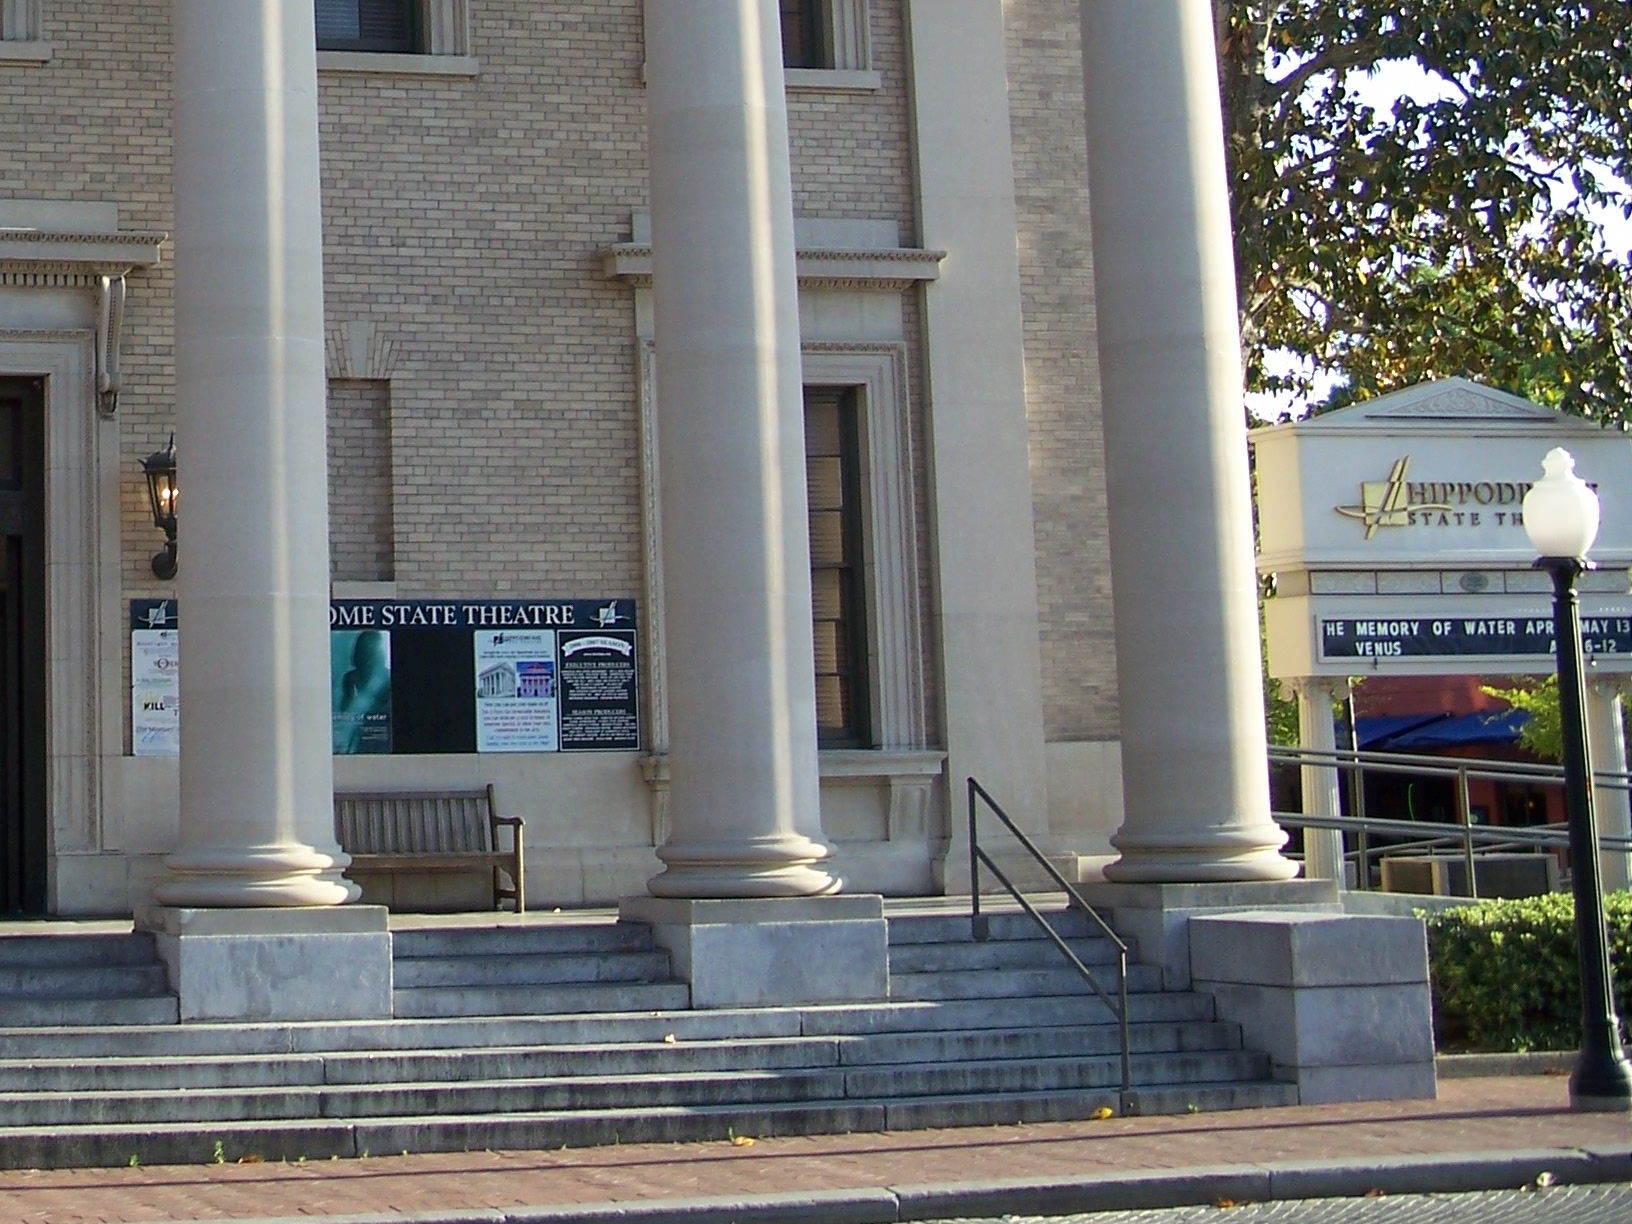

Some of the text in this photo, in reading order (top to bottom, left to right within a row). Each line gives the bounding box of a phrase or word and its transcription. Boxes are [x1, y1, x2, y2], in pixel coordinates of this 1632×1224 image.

[1407, 512, 1481, 527] STATE
[381, 605, 457, 626] STATE
[463, 604, 575, 625] THEATRE
[1356, 621, 1419, 636] MEMORY
[1433, 620, 1452, 635] OF
[1464, 620, 1516, 635] WATER
[1579, 620, 1609, 634] MAY
[1616, 620, 1631, 633] 13
[1355, 641, 1402, 655] VENUS
[144, 702, 165, 711] KILL
